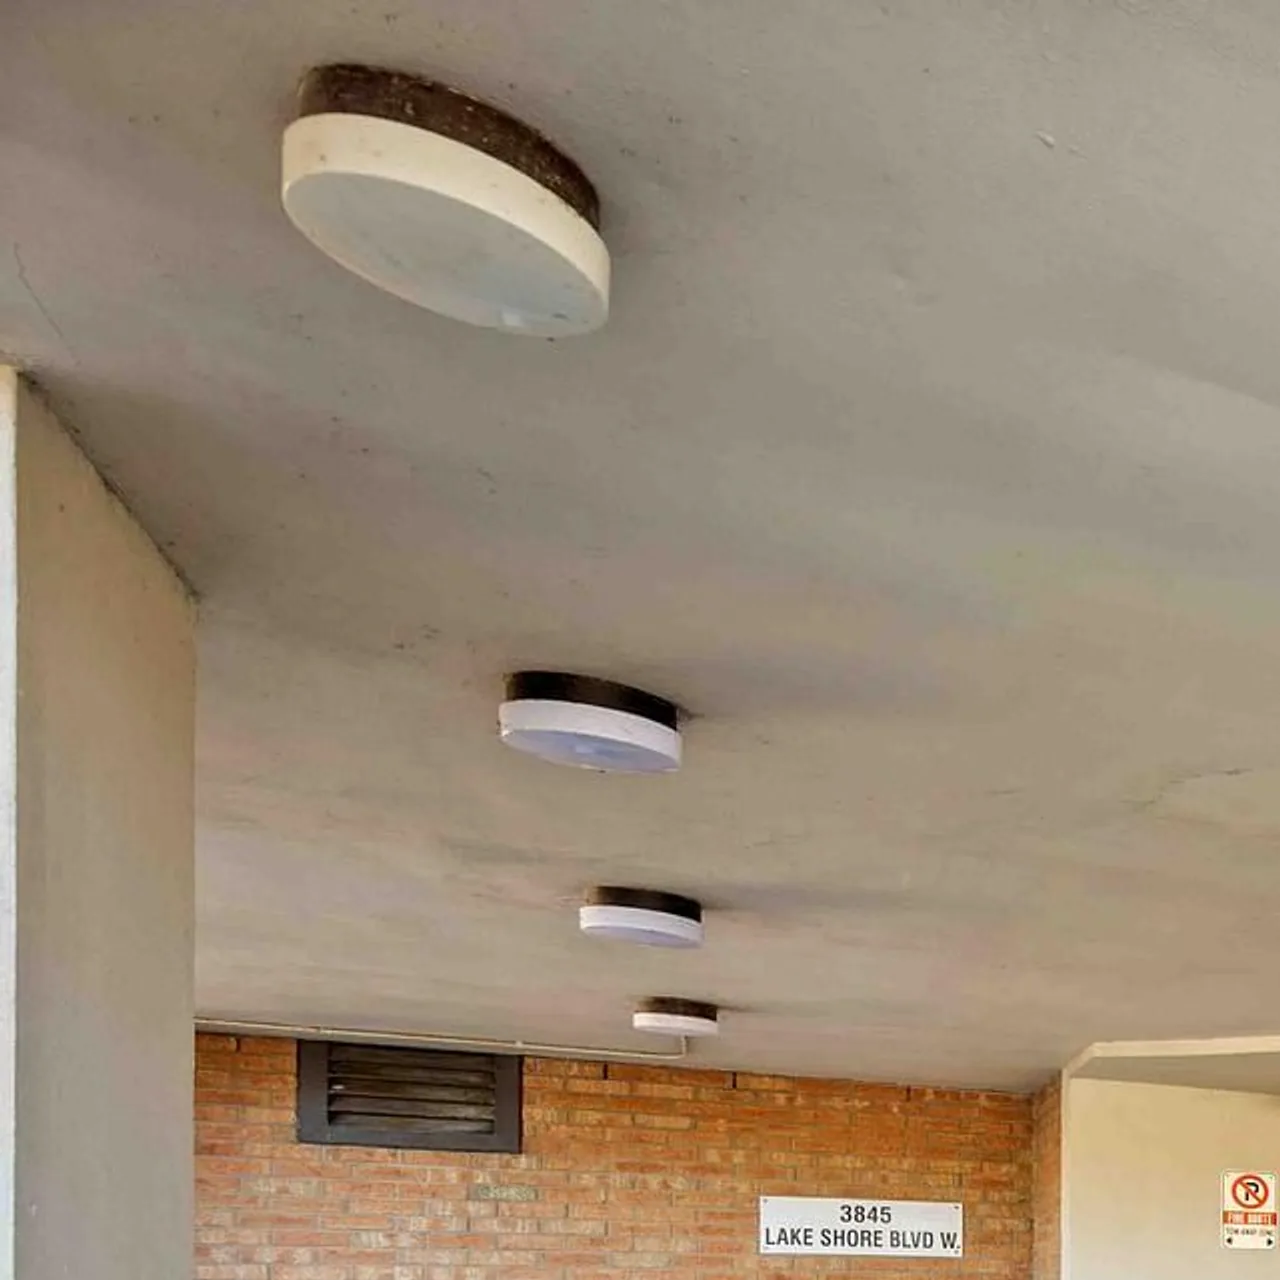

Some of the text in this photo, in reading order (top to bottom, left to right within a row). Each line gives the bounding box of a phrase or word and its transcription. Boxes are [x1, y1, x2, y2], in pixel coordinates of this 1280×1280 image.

[839, 1204, 893, 1224] 3845
[765, 1227, 961, 1250] LAKE SHORE BLVD W.
